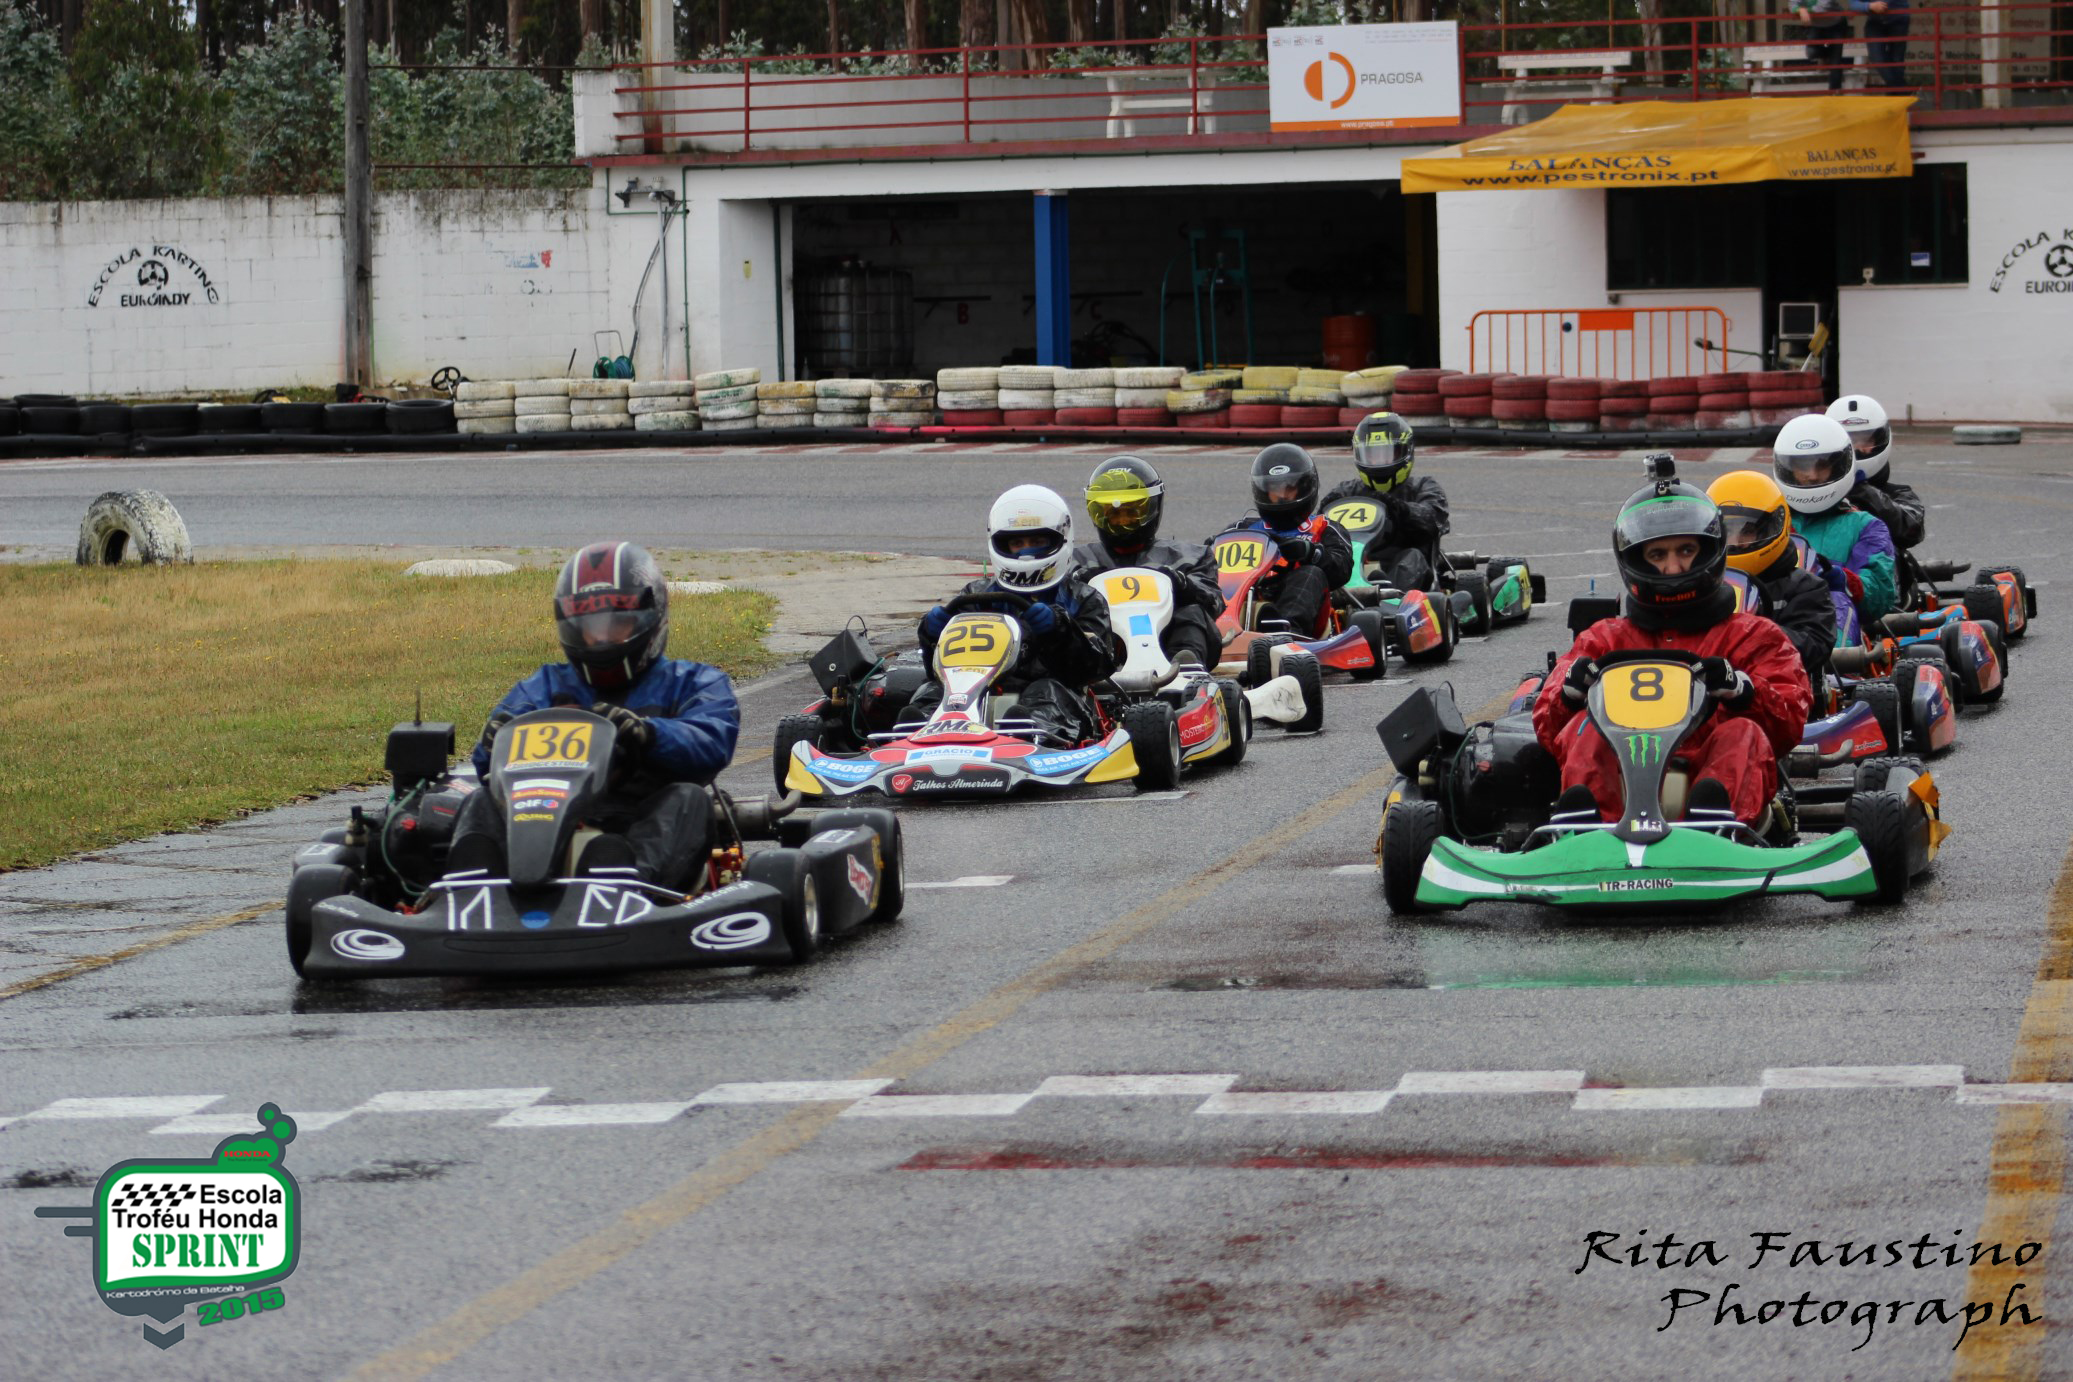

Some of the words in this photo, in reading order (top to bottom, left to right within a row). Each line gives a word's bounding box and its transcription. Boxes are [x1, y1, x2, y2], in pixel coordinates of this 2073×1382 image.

[1360, 72, 1424, 85] PRAGOSA
[1508, 155, 1672, 171] BALANÇAS
[1807, 148, 1878, 163] BALANÇAS
[1461, 169, 1719, 186] www.pestronix.pt
[1989, 231, 2050, 293] ESCOLA
[88, 247, 141, 308] ESCOLA
[153, 245, 219, 305] KARTING
[1333, 508, 1368, 523] 74
[1217, 542, 1257, 569] 104
[1121, 576, 1140, 600] 9
[943, 624, 995, 658] 25
[1629, 667, 1665, 702] 8
[512, 725, 587, 762] 136
[924, 748, 974, 756] GRACIO
[1042, 748, 1102, 766] BOGE
[828, 763, 875, 773] BOGE
[913, 780, 945, 790] Talhos
[948, 778, 1003, 789] Almerinda
